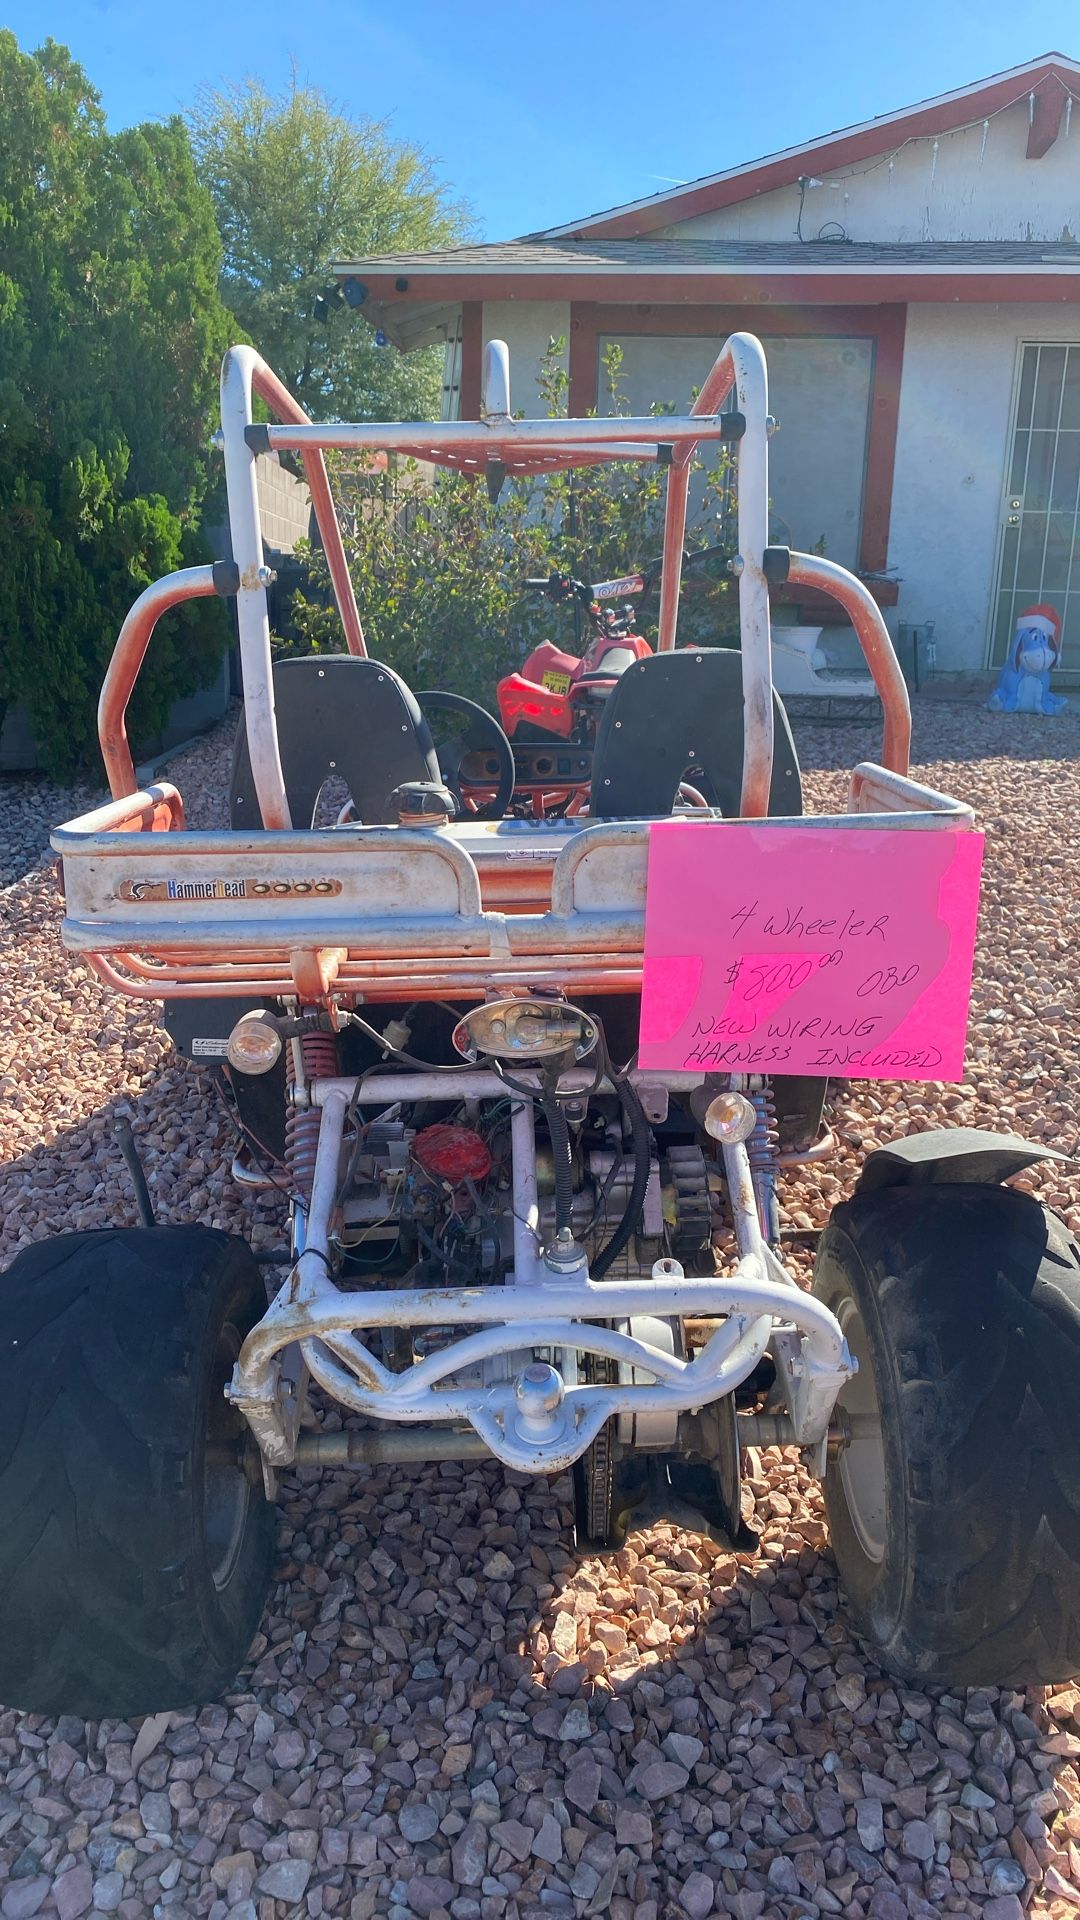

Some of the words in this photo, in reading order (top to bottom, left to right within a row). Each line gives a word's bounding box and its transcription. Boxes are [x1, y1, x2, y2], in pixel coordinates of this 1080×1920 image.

[168, 879, 246, 898] Hammerhead
[731, 901, 758, 939] 4
[856, 964, 920, 998] OBO
[692, 1013, 757, 1038] NEW
[767, 1015, 883, 1038] WIRING
[683, 1041, 791, 1068] HARNESS
[806, 1046, 942, 1068] INCLUDED
